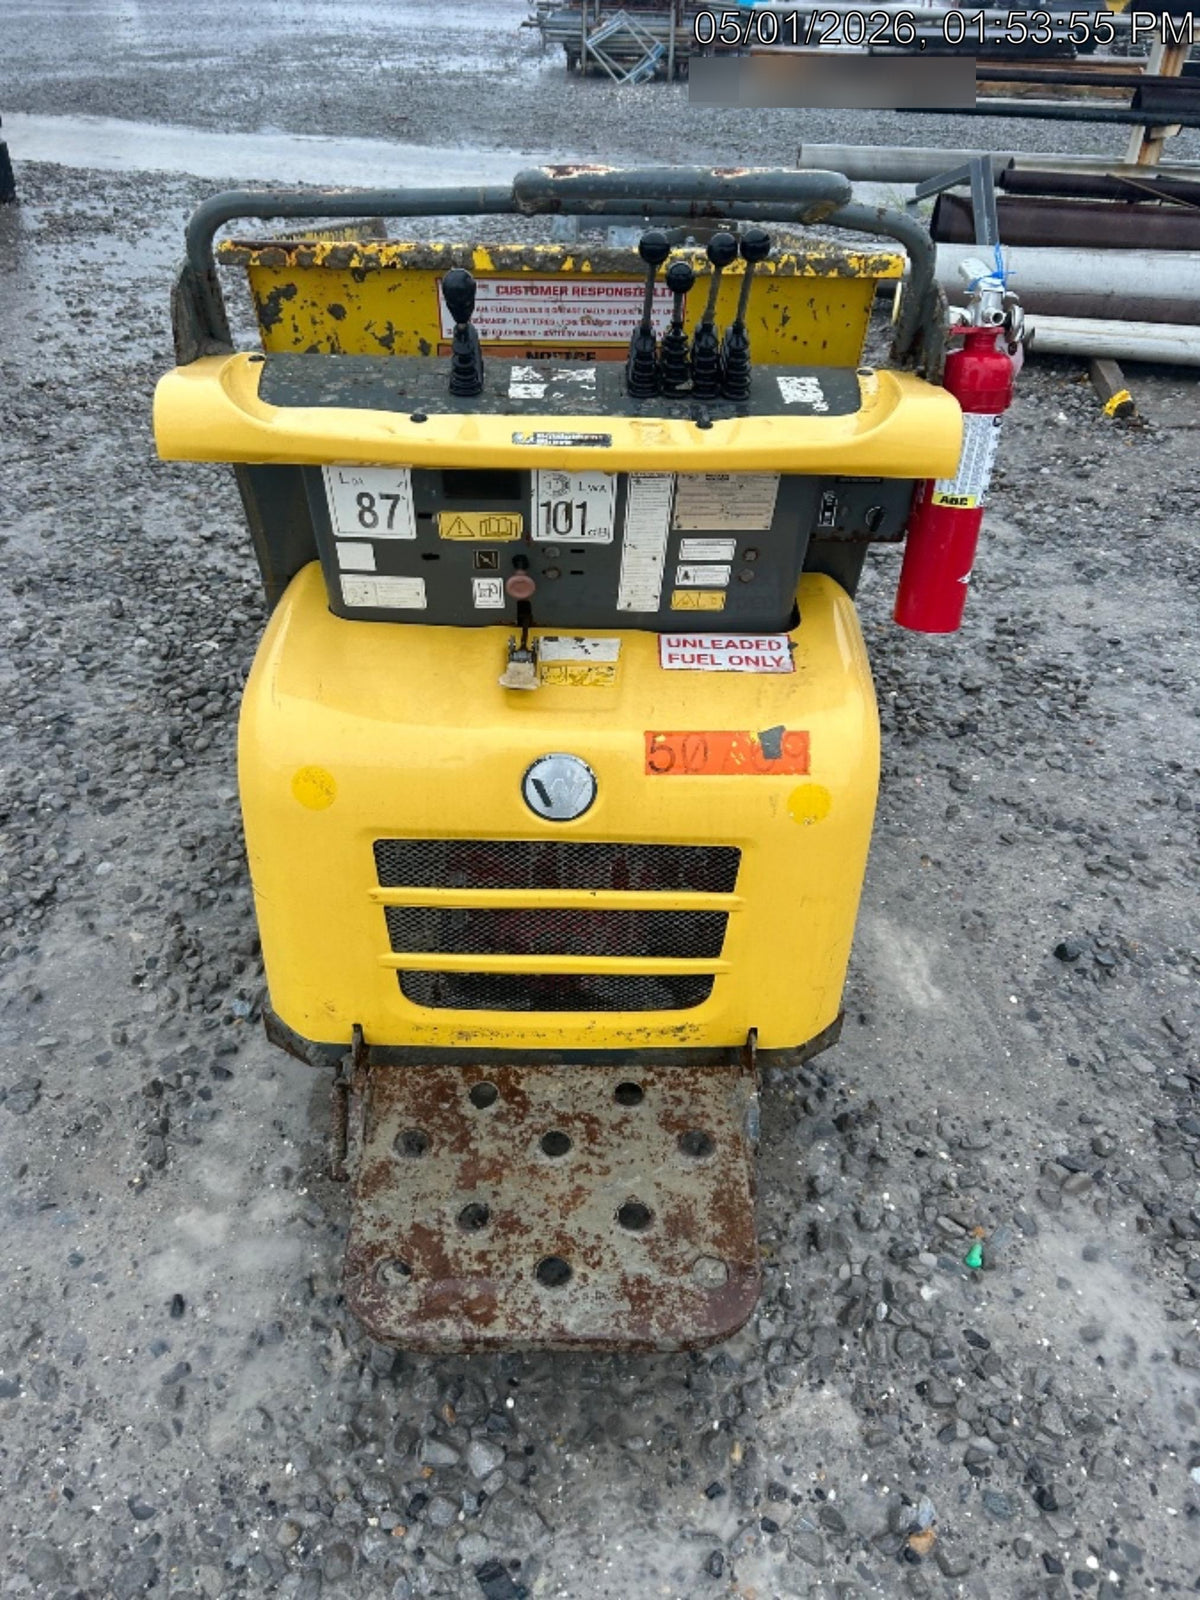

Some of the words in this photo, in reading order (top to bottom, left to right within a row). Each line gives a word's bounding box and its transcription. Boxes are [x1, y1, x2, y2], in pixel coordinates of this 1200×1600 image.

[495, 285, 569, 297] CUSTOMER
[572, 286, 674, 298] RESPONSIBLIT
[356, 491, 401, 530] 87
[540, 499, 588, 536] 101
[666, 637, 783, 652] UNLEADED
[667, 653, 723, 667] FUEL
[727, 654, 785, 668] ONLY
